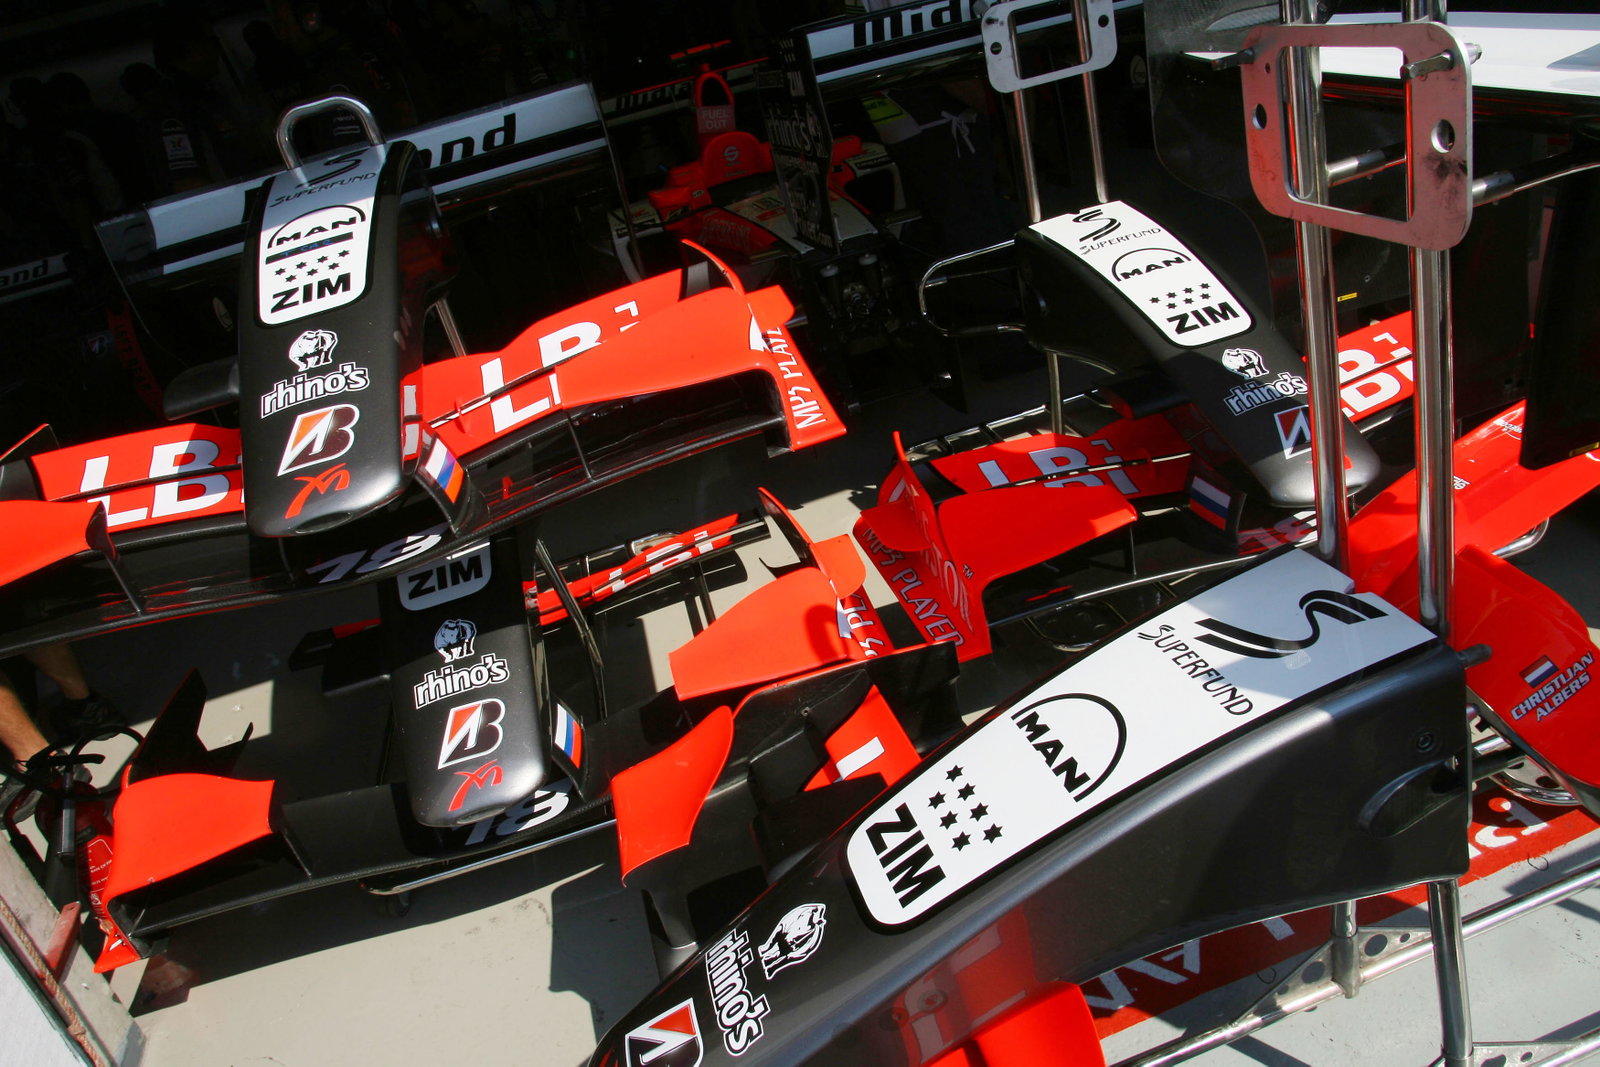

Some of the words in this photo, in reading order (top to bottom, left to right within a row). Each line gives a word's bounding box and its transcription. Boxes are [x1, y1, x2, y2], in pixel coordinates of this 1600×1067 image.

[276, 216, 356, 246] MAN
[1079, 227, 1162, 256] SUPERFUND
[1120, 256, 1185, 281] MAN
[270, 272, 351, 314] ZIM
[1166, 301, 1240, 335] ZIM
[260, 361, 371, 420] rhino's
[1224, 371, 1308, 416] rhino's
[408, 555, 484, 600] ZIM
[414, 653, 510, 710] rhino's
[1137, 624, 1254, 716] SUPERFUND
[1536, 671, 1591, 722] ALBERS
[1016, 710, 1091, 793] MAN
[865, 802, 947, 908] ZIM
[705, 928, 771, 1057] rhino's
